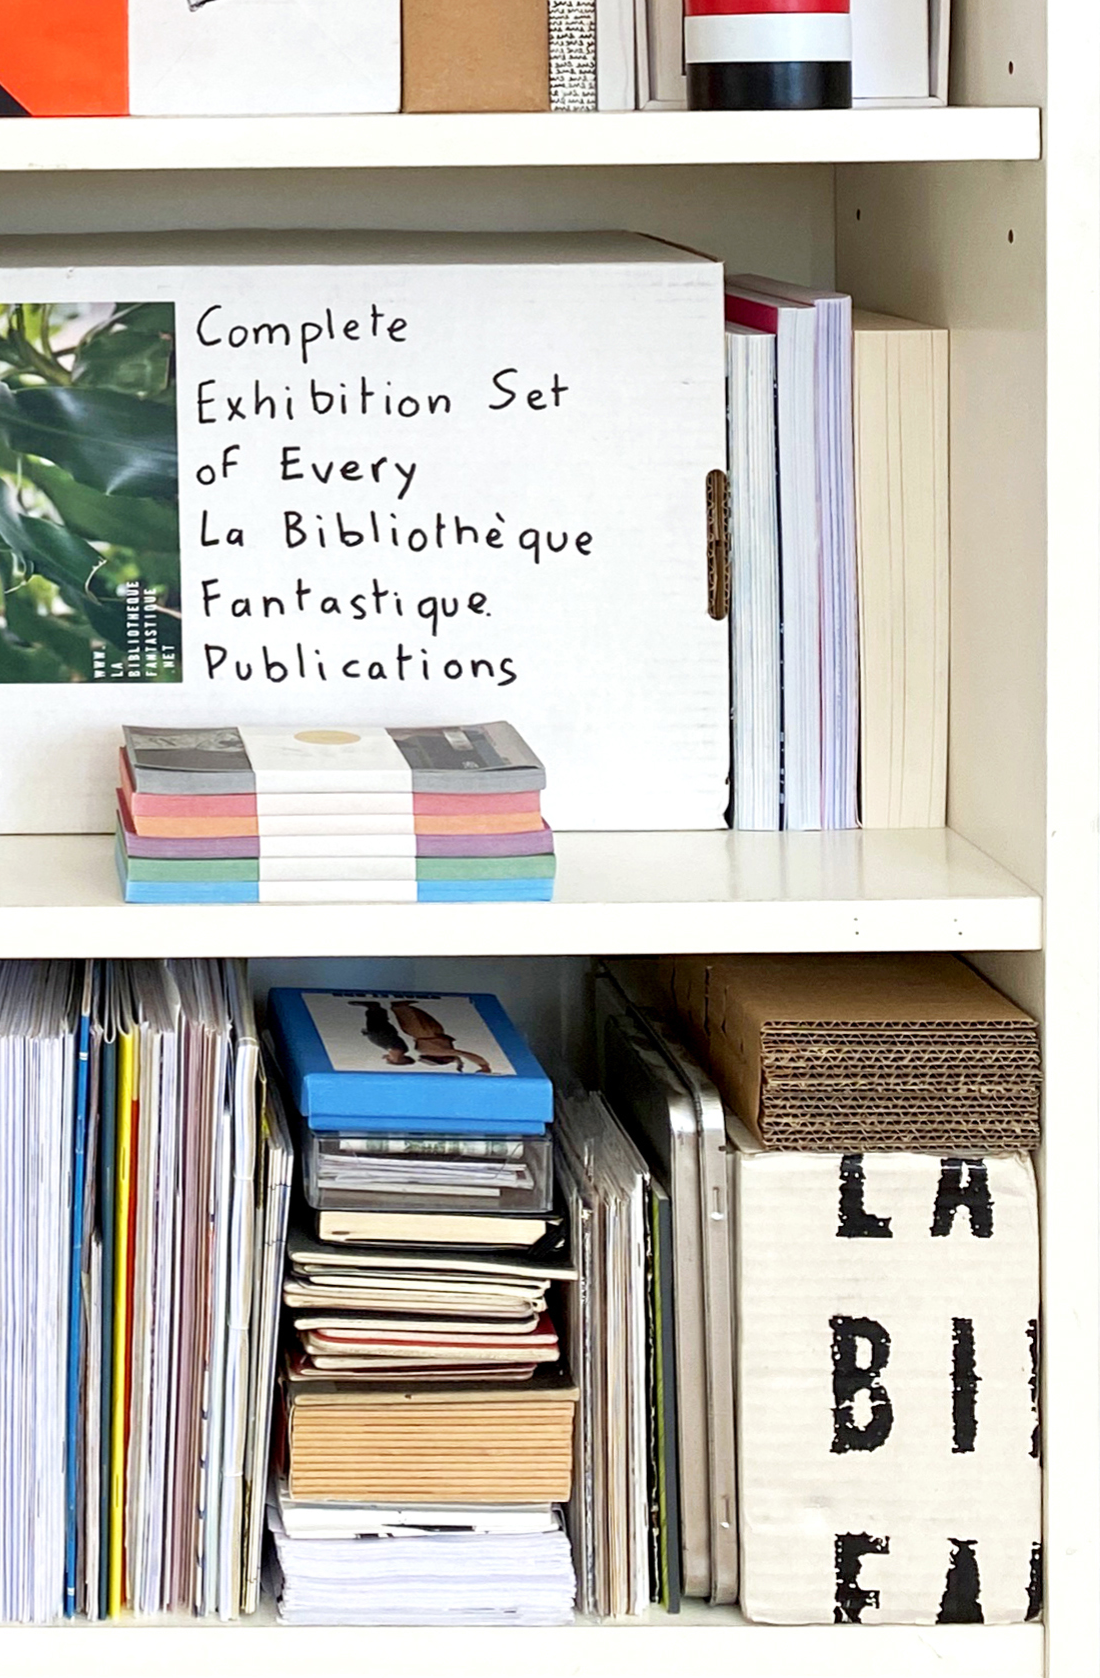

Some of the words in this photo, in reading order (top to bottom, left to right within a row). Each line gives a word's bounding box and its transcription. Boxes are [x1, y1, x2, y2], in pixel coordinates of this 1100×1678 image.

[196, 304, 408, 363] Complete
[197, 377, 452, 424] Exhibition
[488, 368, 570, 413] Set
[196, 444, 239, 486] of
[279, 446, 417, 498] Every
[201, 509, 244, 547] La
[283, 511, 594, 565] Bibliothèque
[126, 581, 141, 678] BIBLIOTHEQUE
[143, 588, 158, 677] FANTASTIQUE
[110, 662, 124, 678] LA
[205, 641, 517, 688] Publications
[835, 1154, 995, 1239] LA
[828, 1315, 1040, 1459] BI
[833, 1532, 1042, 1623] FA
